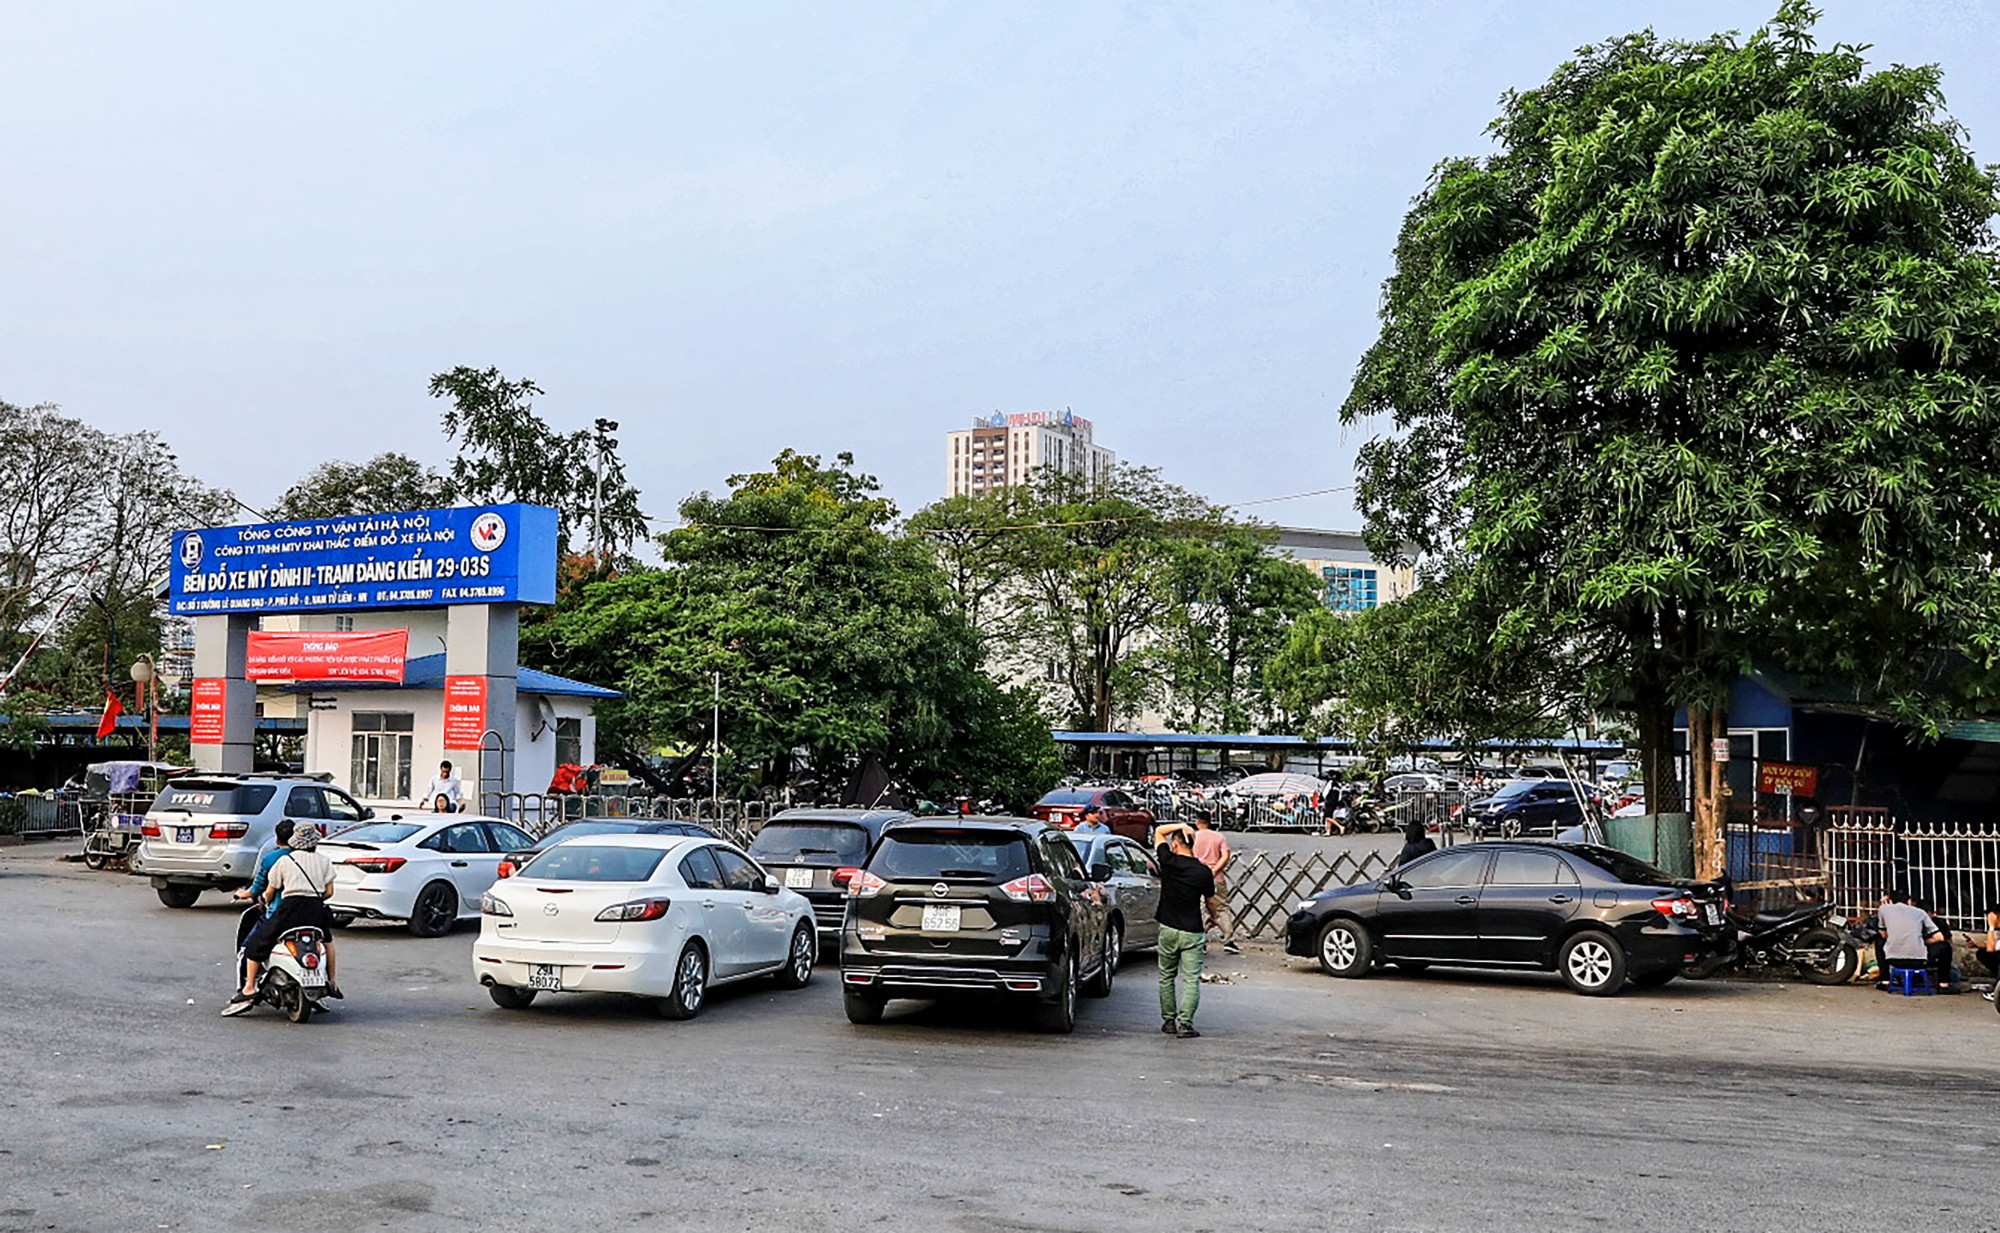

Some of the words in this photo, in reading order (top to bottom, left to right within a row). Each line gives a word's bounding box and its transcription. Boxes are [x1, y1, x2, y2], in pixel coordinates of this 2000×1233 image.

[315, 525, 330, 535] TY
[381, 516, 400, 530] HÀ
[403, 515, 430, 531] NỘI
[244, 547, 256, 555] TY
[257, 544, 281, 554] TNHH
[281, 543, 301, 553] MTV
[303, 540, 325, 551] KHAI
[325, 536, 350, 549] THÁC
[400, 533, 415, 544] XE
[417, 528, 433, 543] HÀ
[434, 527, 455, 543] NỘI
[183, 568, 206, 593] BẾN
[208, 563, 227, 591] ĐỖ
[229, 571, 246, 590] XE
[247, 564, 268, 588] MỸ
[270, 563, 300, 588] ĐÌNH
[356, 556, 395, 582] ĐĂNG
[397, 547, 433, 580] KIỂM
